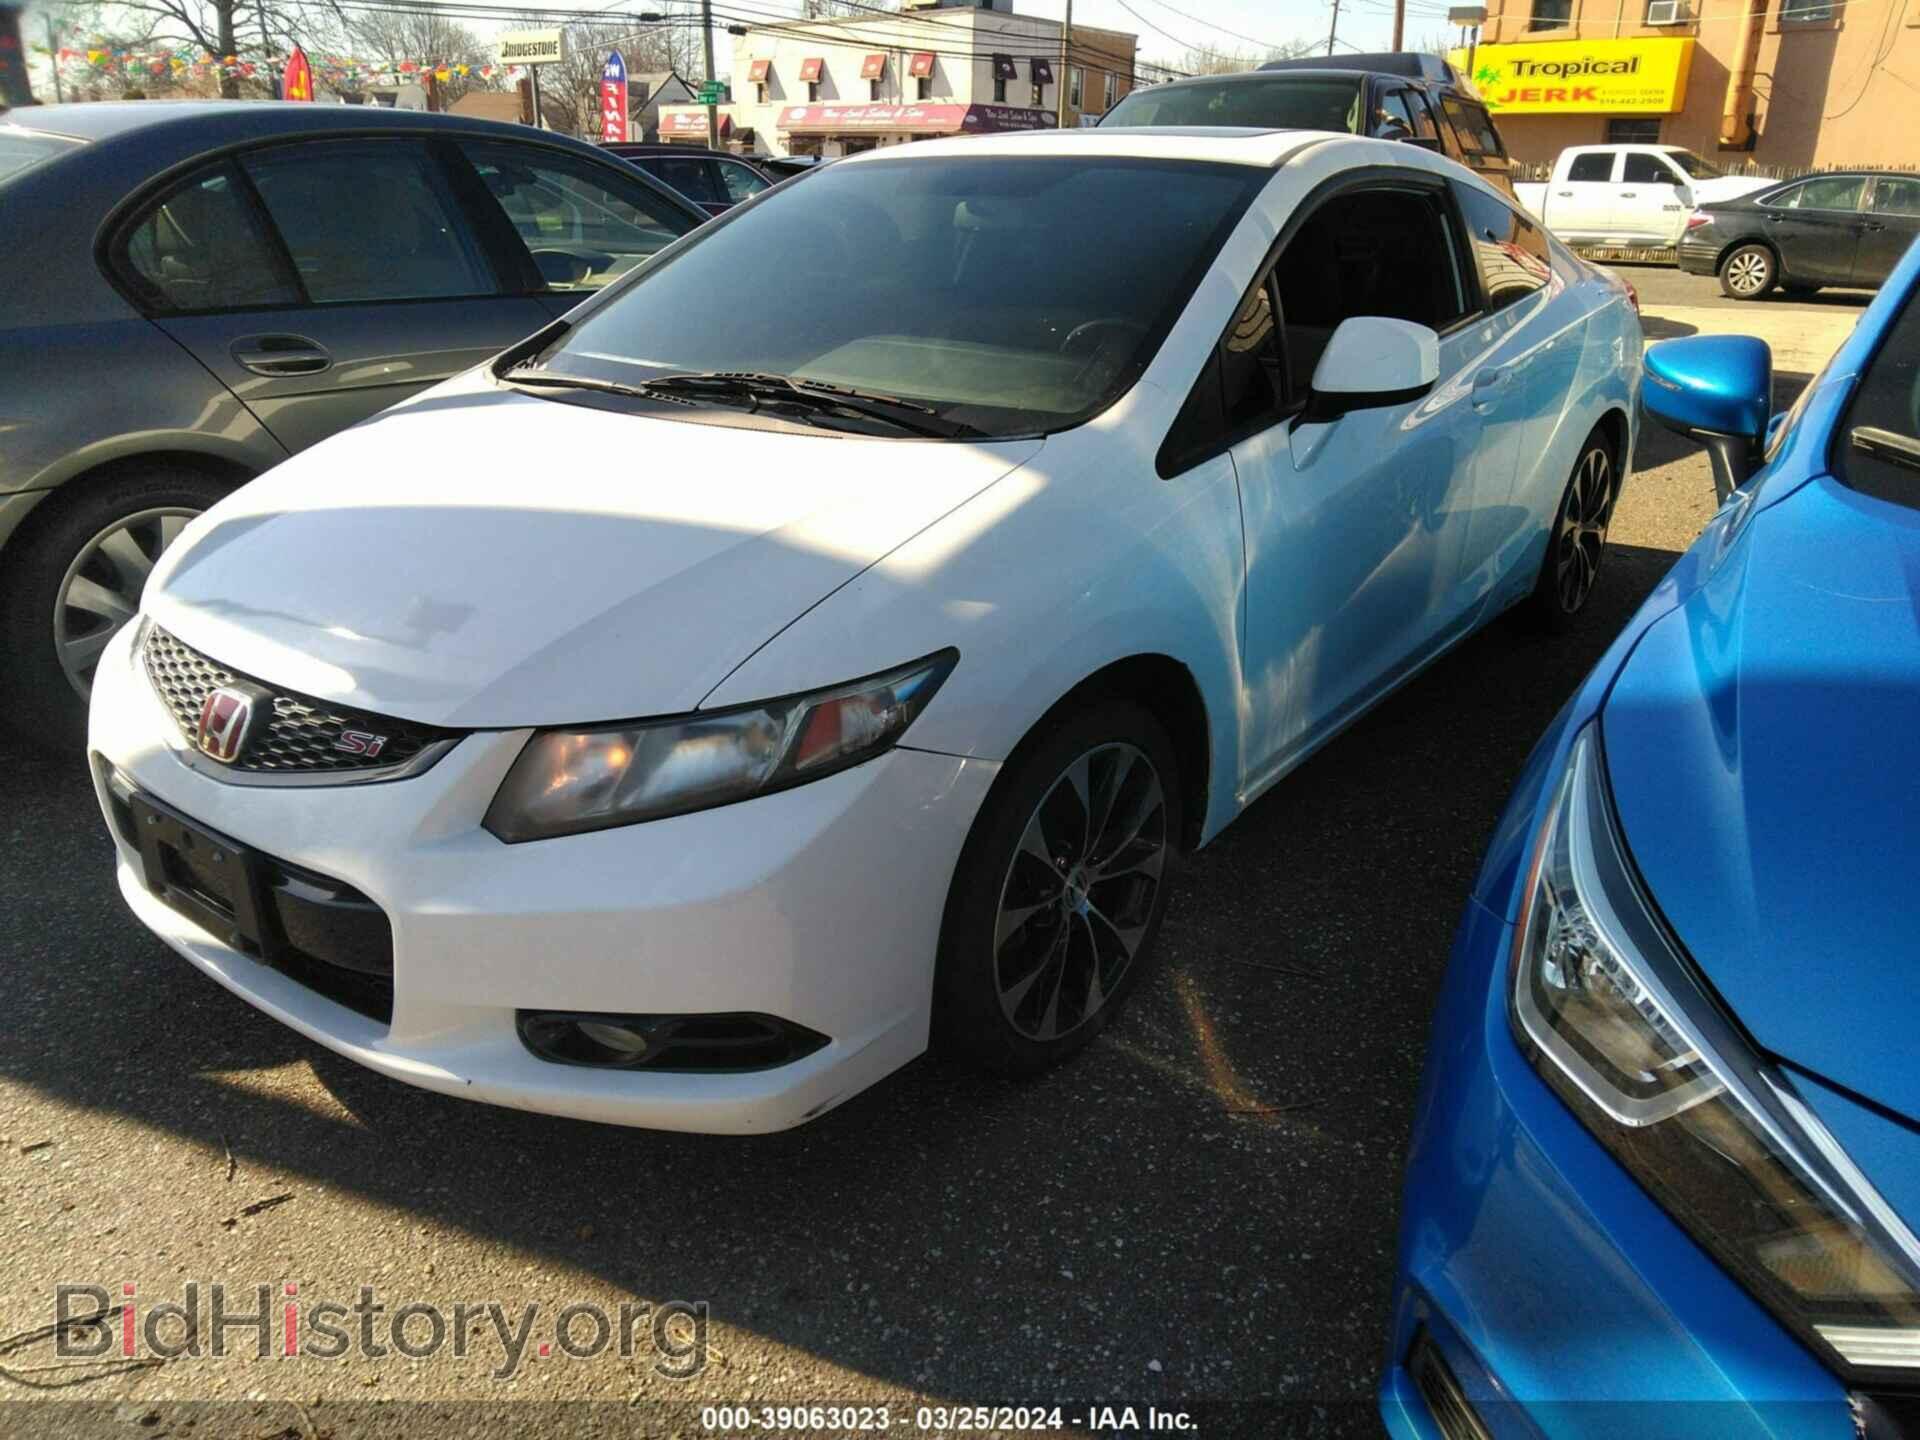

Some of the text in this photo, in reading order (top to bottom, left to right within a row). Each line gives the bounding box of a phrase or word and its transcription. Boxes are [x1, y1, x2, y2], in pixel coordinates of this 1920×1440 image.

[501, 40, 558, 57] BRIDGESTONE
[1510, 56, 1640, 78] Tropical
[1497, 86, 1599, 104] JERK
[334, 730, 388, 757] Si
